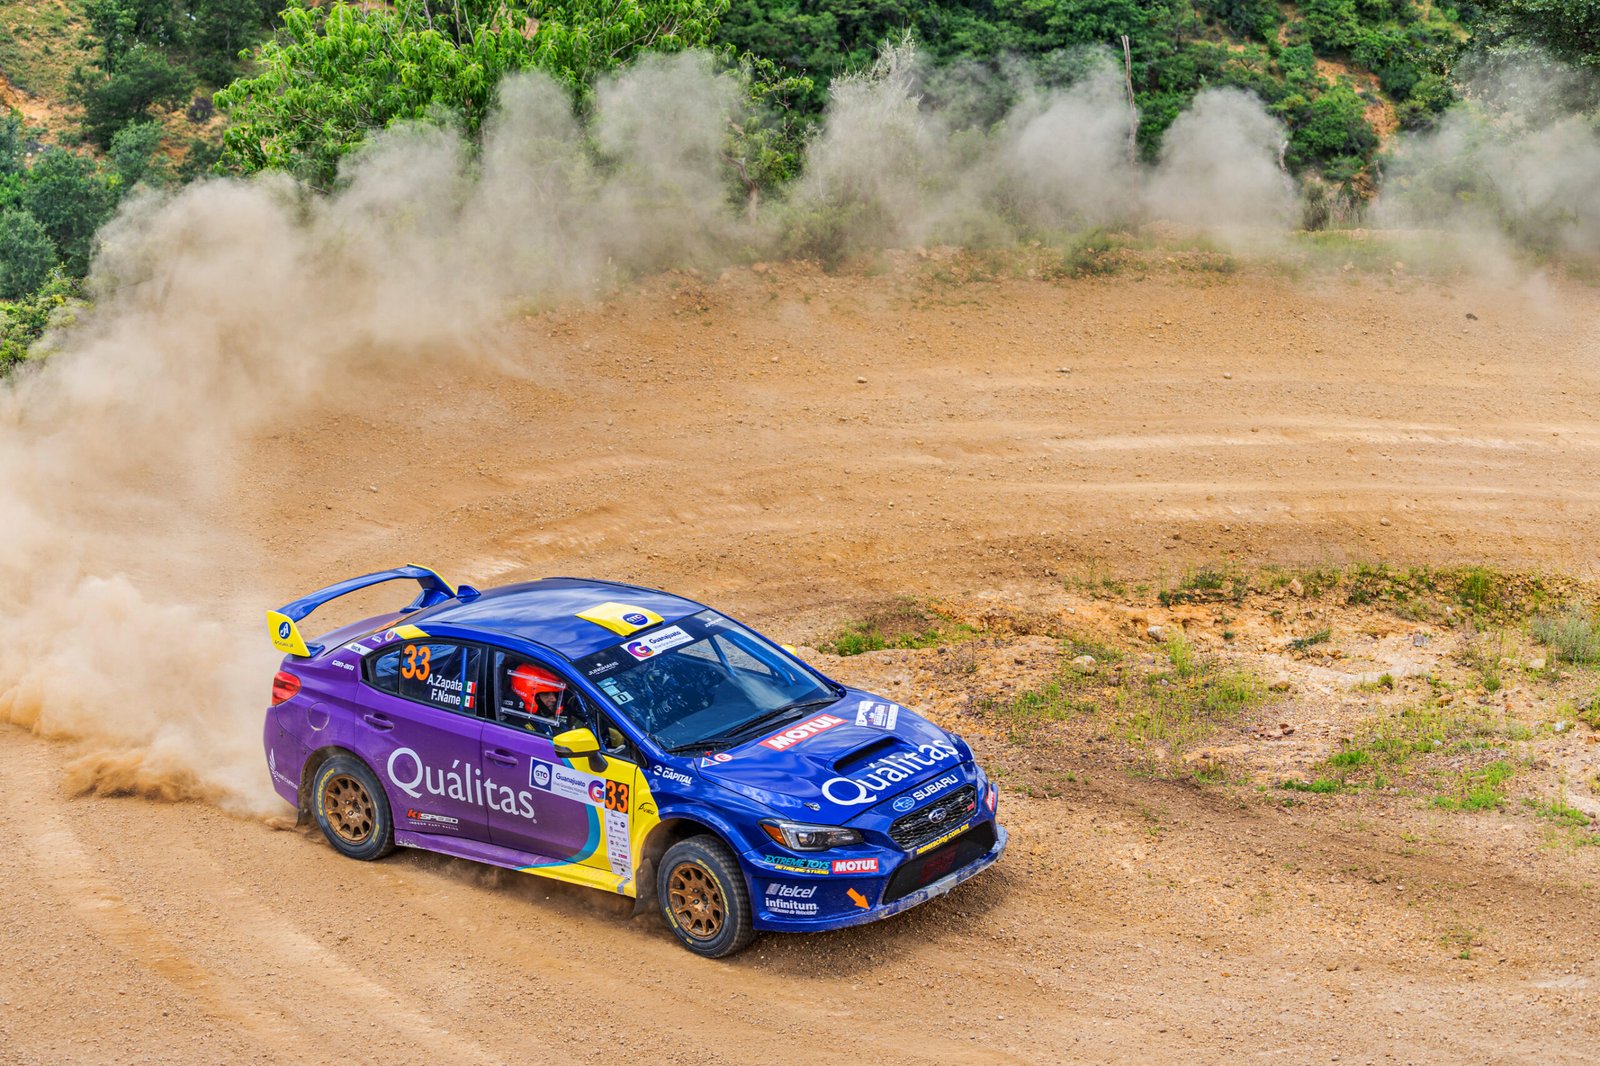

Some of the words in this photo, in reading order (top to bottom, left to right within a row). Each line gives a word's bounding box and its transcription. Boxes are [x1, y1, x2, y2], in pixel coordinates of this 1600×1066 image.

[649, 631, 681, 644] Guanajuato
[401, 644, 431, 680] 33
[426, 673, 463, 692] A.Zapata
[430, 688, 461, 706] F.Name
[767, 716, 844, 750] MOTUL
[535, 769, 548, 779] GTO
[555, 772, 586, 788] Guanajuato
[662, 770, 692, 785] CAPITAL
[821, 740, 959, 806] Quálitas
[387, 747, 536, 819] Quálitas
[912, 774, 959, 801] SUBARU
[605, 780, 629, 813] 33
[764, 854, 805, 867] EXTREME
[806, 859, 830, 870] TOYS
[834, 859, 877, 872] MOTUL
[778, 884, 817, 898] telcel
[765, 897, 817, 910] infinitum
